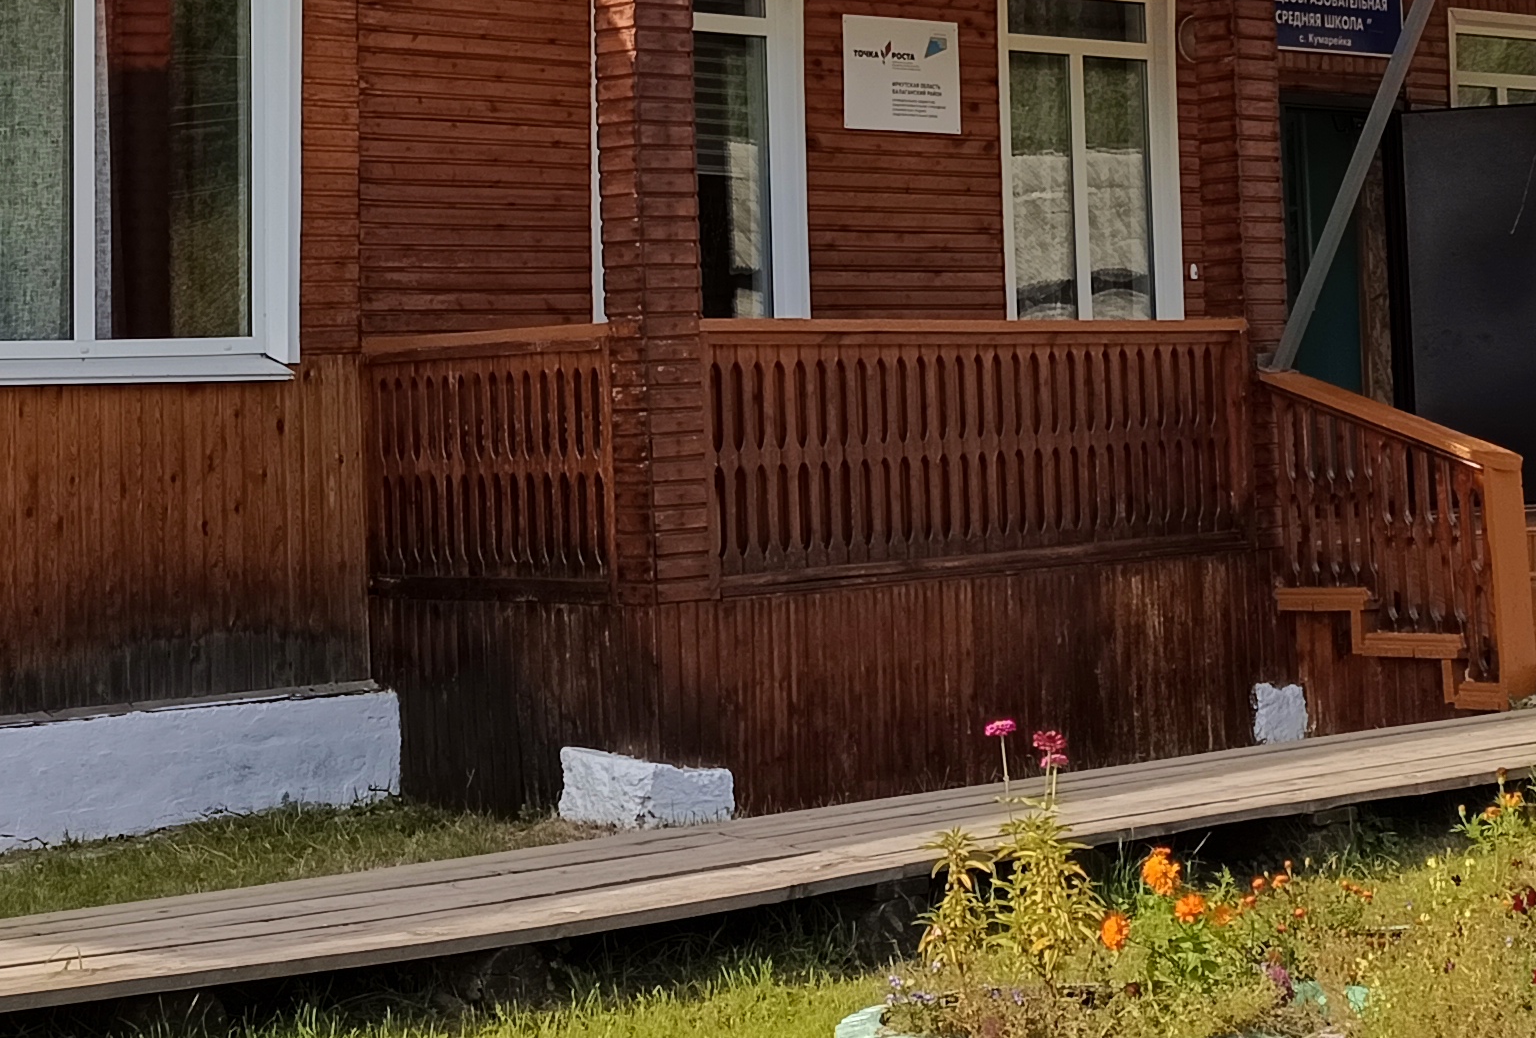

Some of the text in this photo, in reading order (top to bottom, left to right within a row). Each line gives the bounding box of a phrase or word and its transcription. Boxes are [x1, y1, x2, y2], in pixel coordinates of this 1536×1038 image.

[1275, 10, 1322, 29] СРЕДНЯЯ
[1324, 14, 1364, 31] ШКОЛА
[1308, 33, 1352, 48] Кумарейка
[853, 49, 915, 61] ТОЧКА РОСТА
